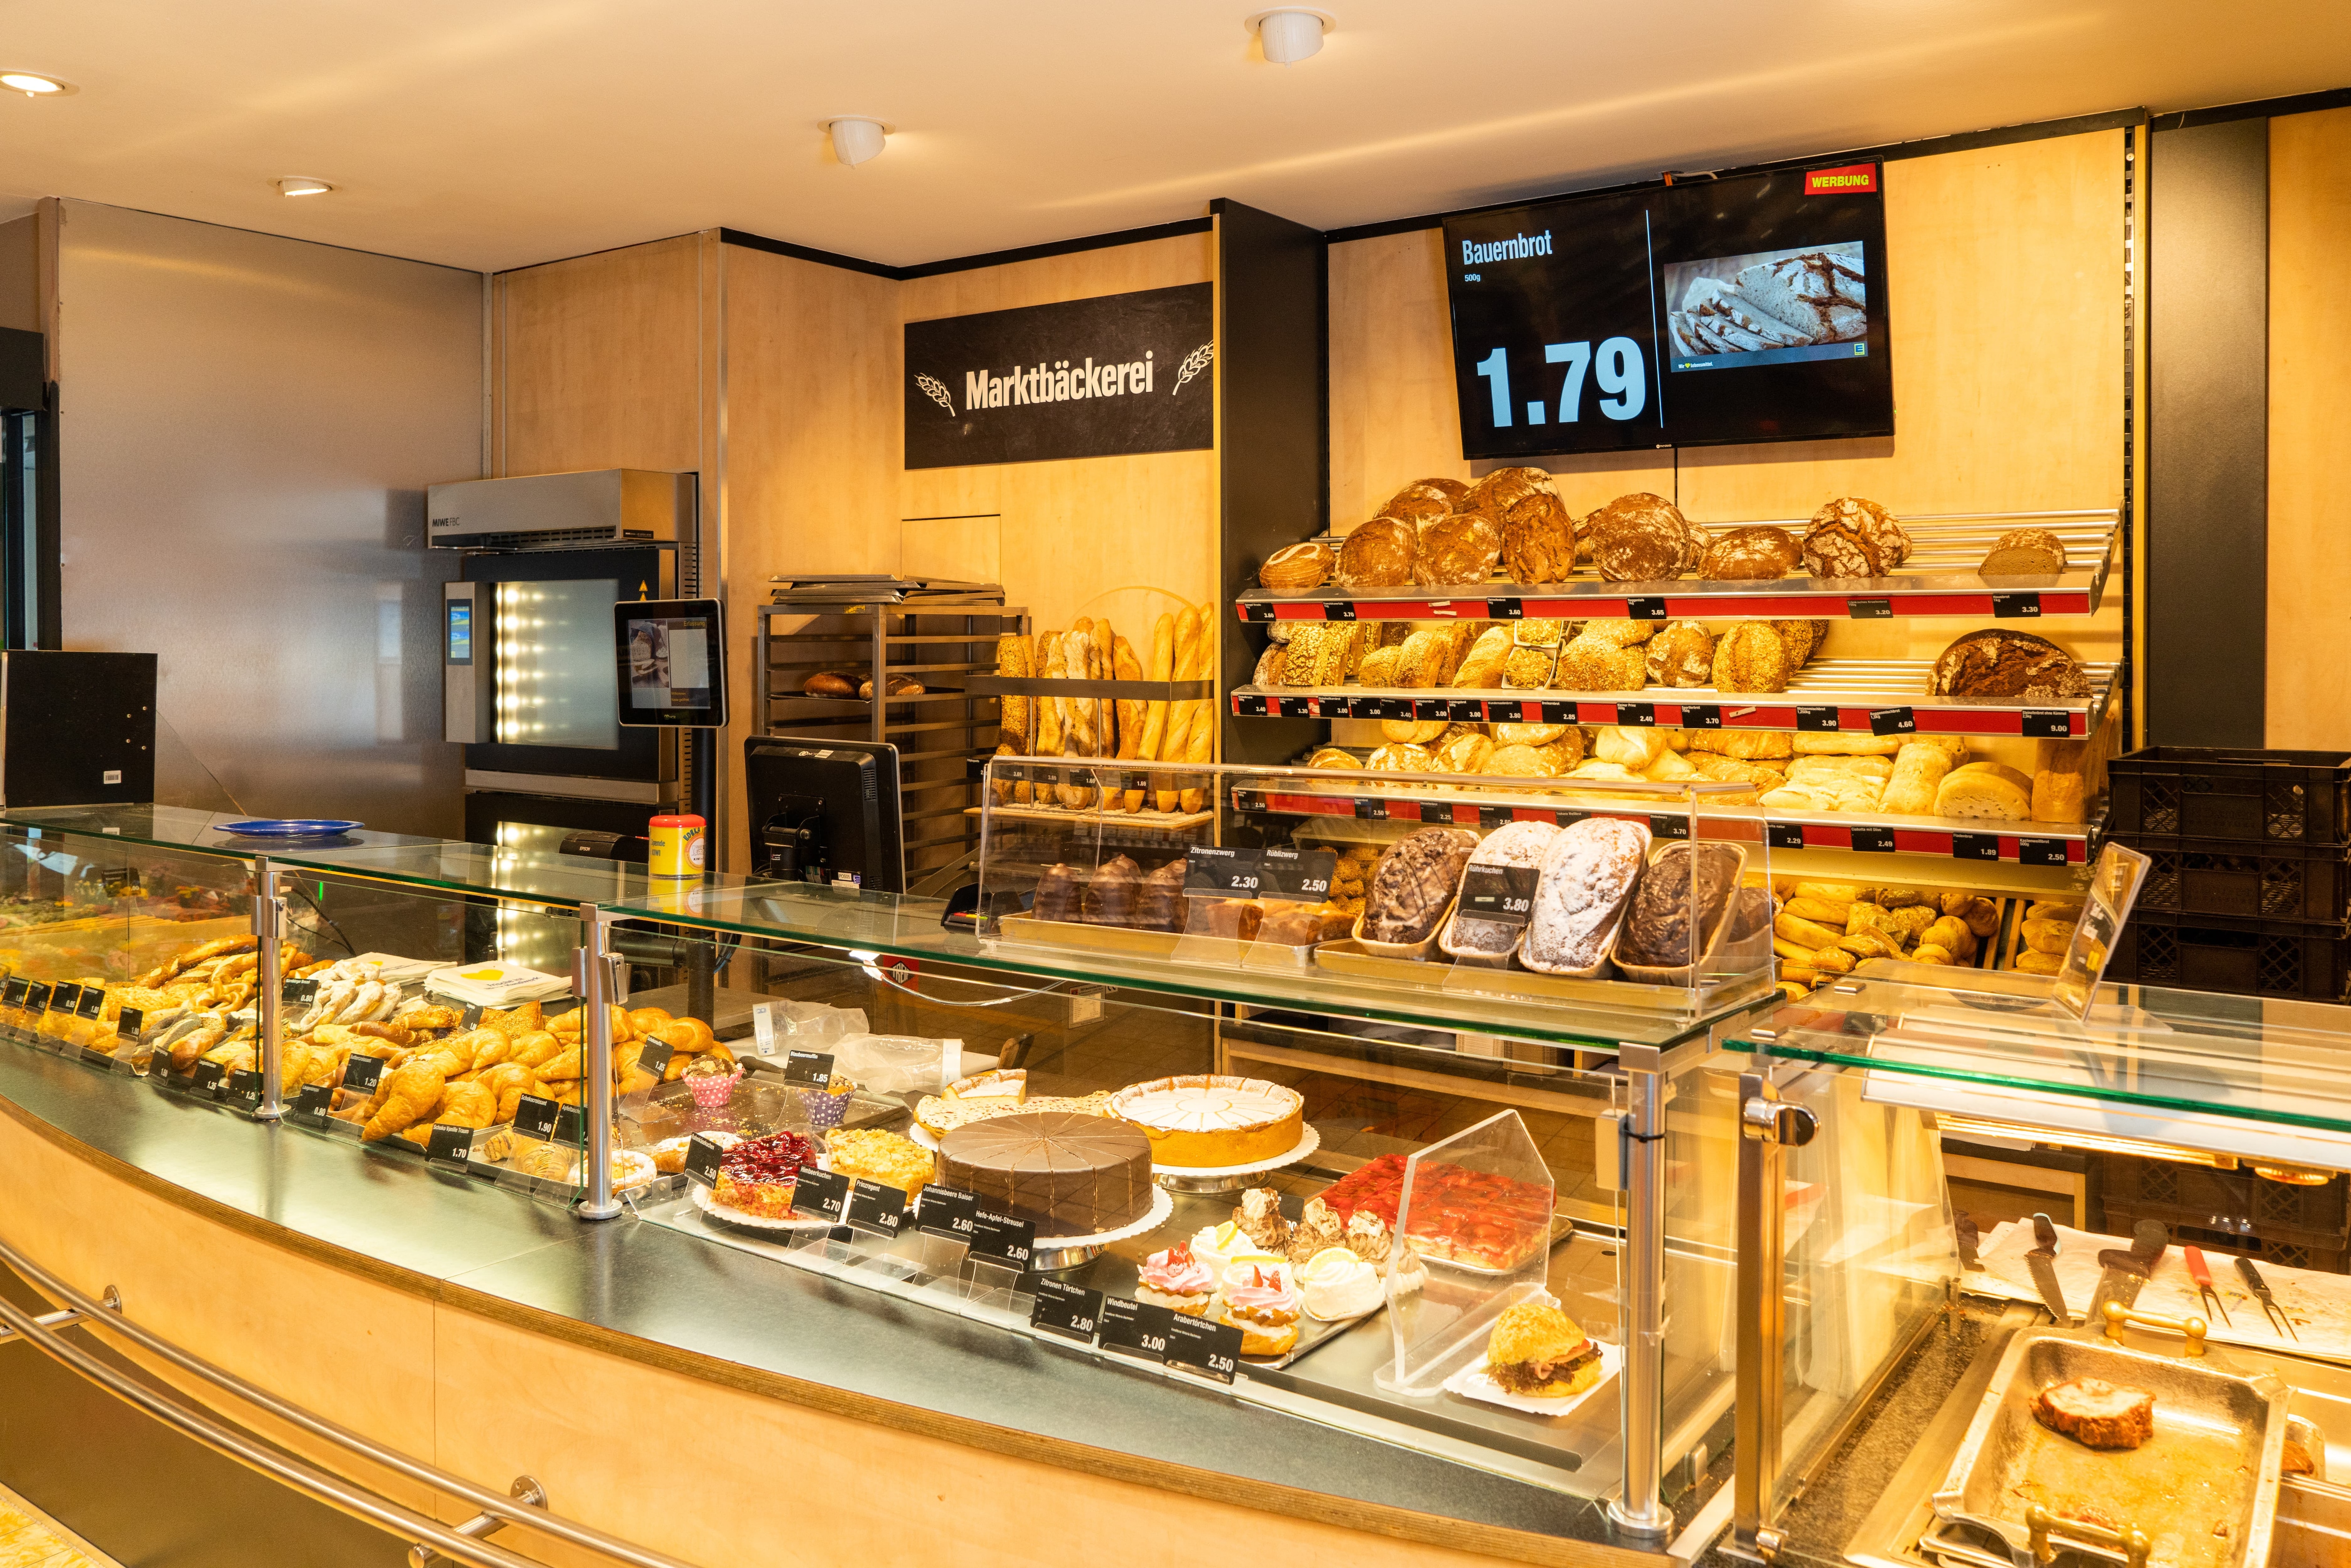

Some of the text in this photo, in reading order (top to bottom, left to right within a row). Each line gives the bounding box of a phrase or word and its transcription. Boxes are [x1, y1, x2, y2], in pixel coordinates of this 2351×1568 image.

[1812, 173, 1869, 188] WERBUNG
[1462, 229, 1553, 266] Bauernbrot
[1464, 274, 1481, 283] 500g
[966, 350, 1153, 410] Marktbäckerei
[1476, 337, 1646, 427] 1.79
[432, 517, 460, 527] MIWE FBC
[683, 827, 701, 841] EDEKA
[1191, 847, 1235, 858] Zitronenzwerg
[1267, 850, 1298, 859] Rüblizwerg
[1468, 865, 1503, 875] Rührkuchen
[1231, 875, 1258, 888] 2.30
[1302, 879, 1327, 892] 2.50
[1503, 897, 1529, 912] 3.80
[790, 1051, 818, 1059] Blaubeermuffin
[655, 1060, 666, 1072] 1.85
[365, 1077, 377, 1087] 1.20
[813, 1072, 828, 1083] 1.85
[207, 1080, 217, 1090] 1.35
[521, 1094, 547, 1106] Schokocroissant
[314, 1106, 326, 1117] 0.80
[538, 1121, 552, 1133] 1.90
[452, 1148, 467, 1158] 1.70
[704, 1165, 716, 1180] 2.50
[800, 1166, 832, 1180] Himbeerkuchen
[856, 1179, 881, 1192] Prinzregent
[923, 1185, 974, 1201] Johannisbeere Baiser
[822, 1198, 841, 1212] 2.70
[879, 1212, 899, 1228] 2.80
[952, 1217, 973, 1232] 2.60
[976, 1210, 1024, 1228] Hefe-Apfel-Streusel
[1007, 1245, 1029, 1261] 2.60
[1041, 1277, 1085, 1296] Zitronen Törtchen
[1106, 1297, 1138, 1311] Windbeutel
[1070, 1315, 1093, 1332] 2.80
[1173, 1313, 1216, 1332] Arabertörtchen
[1141, 1334, 1166, 1351] 3.00
[1208, 1354, 1234, 1372] 2.50
